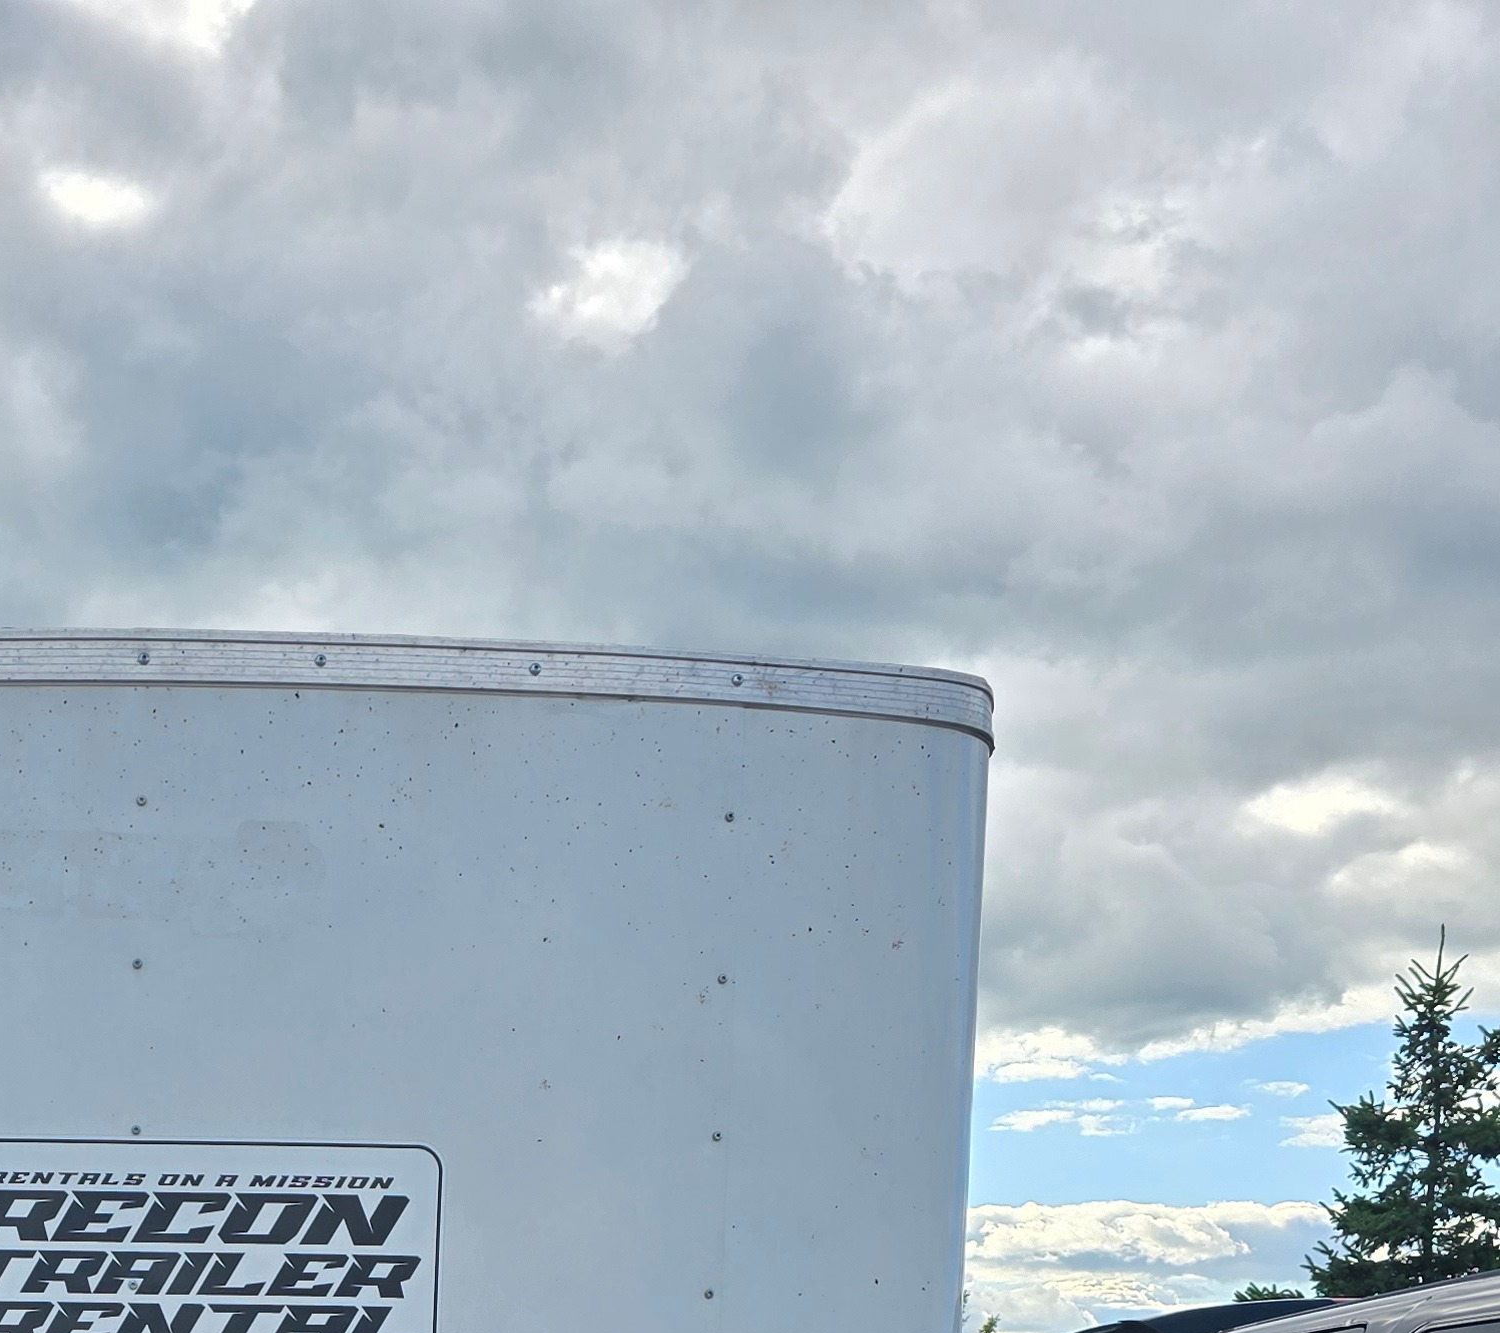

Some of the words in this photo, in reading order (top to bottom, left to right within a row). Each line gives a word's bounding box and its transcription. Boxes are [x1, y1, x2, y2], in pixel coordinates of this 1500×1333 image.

[157, 1173, 204, 1187] ON
[214, 1174, 239, 1188] A
[248, 1174, 395, 1189] MISSION
